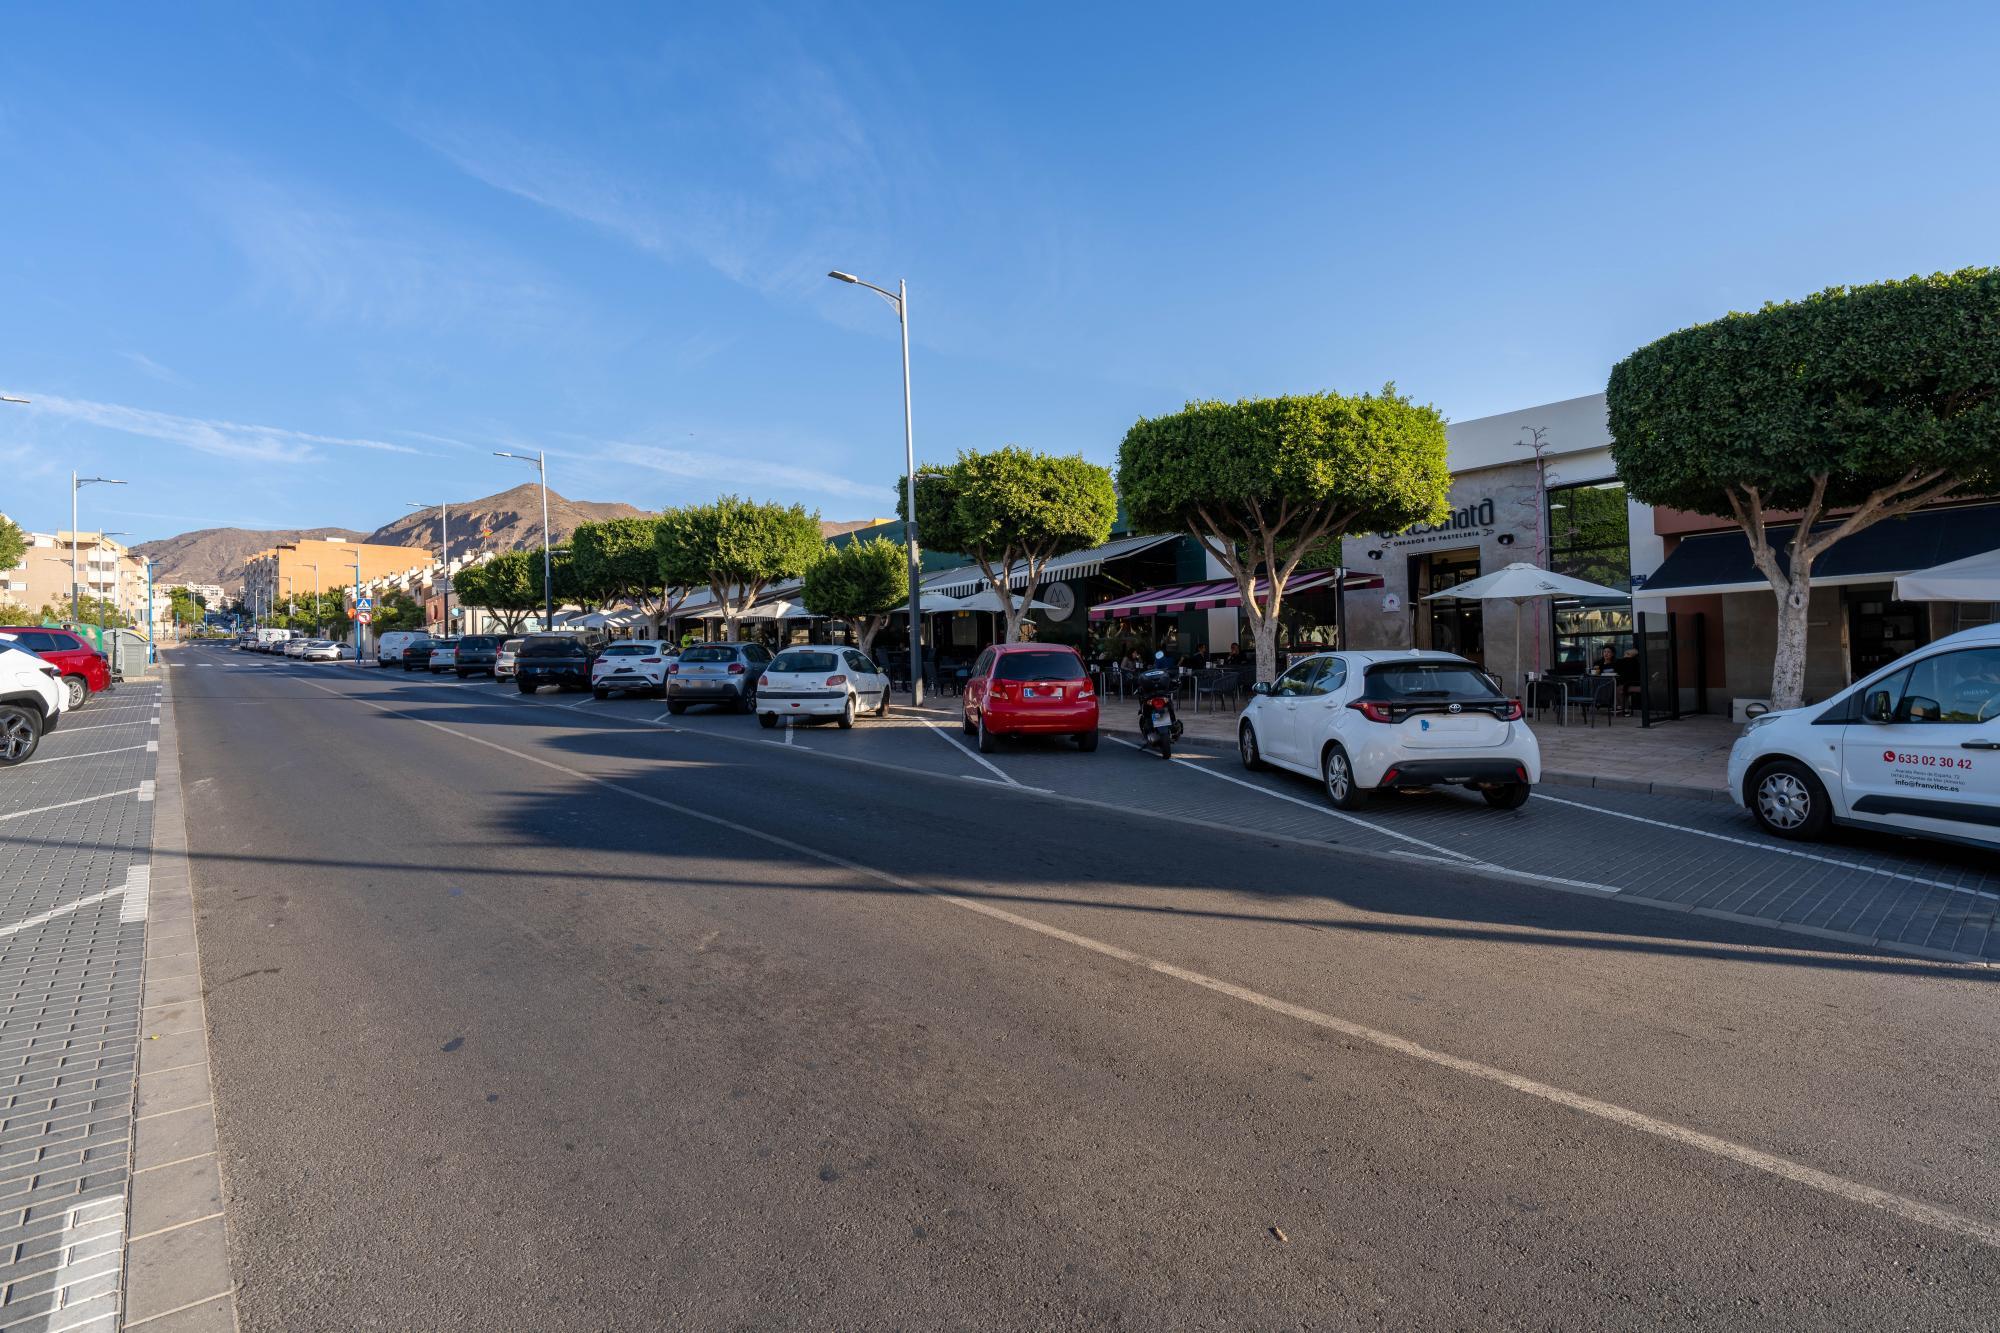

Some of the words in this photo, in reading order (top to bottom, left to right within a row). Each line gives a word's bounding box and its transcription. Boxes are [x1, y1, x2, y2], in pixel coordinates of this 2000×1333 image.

[1898, 753, 1919, 764] 633
[1921, 755, 1936, 767] 02
[1939, 757, 1954, 768] 30
[1957, 759, 1972, 769] 42
[1895, 779, 1960, 792] info@franvitec.es
